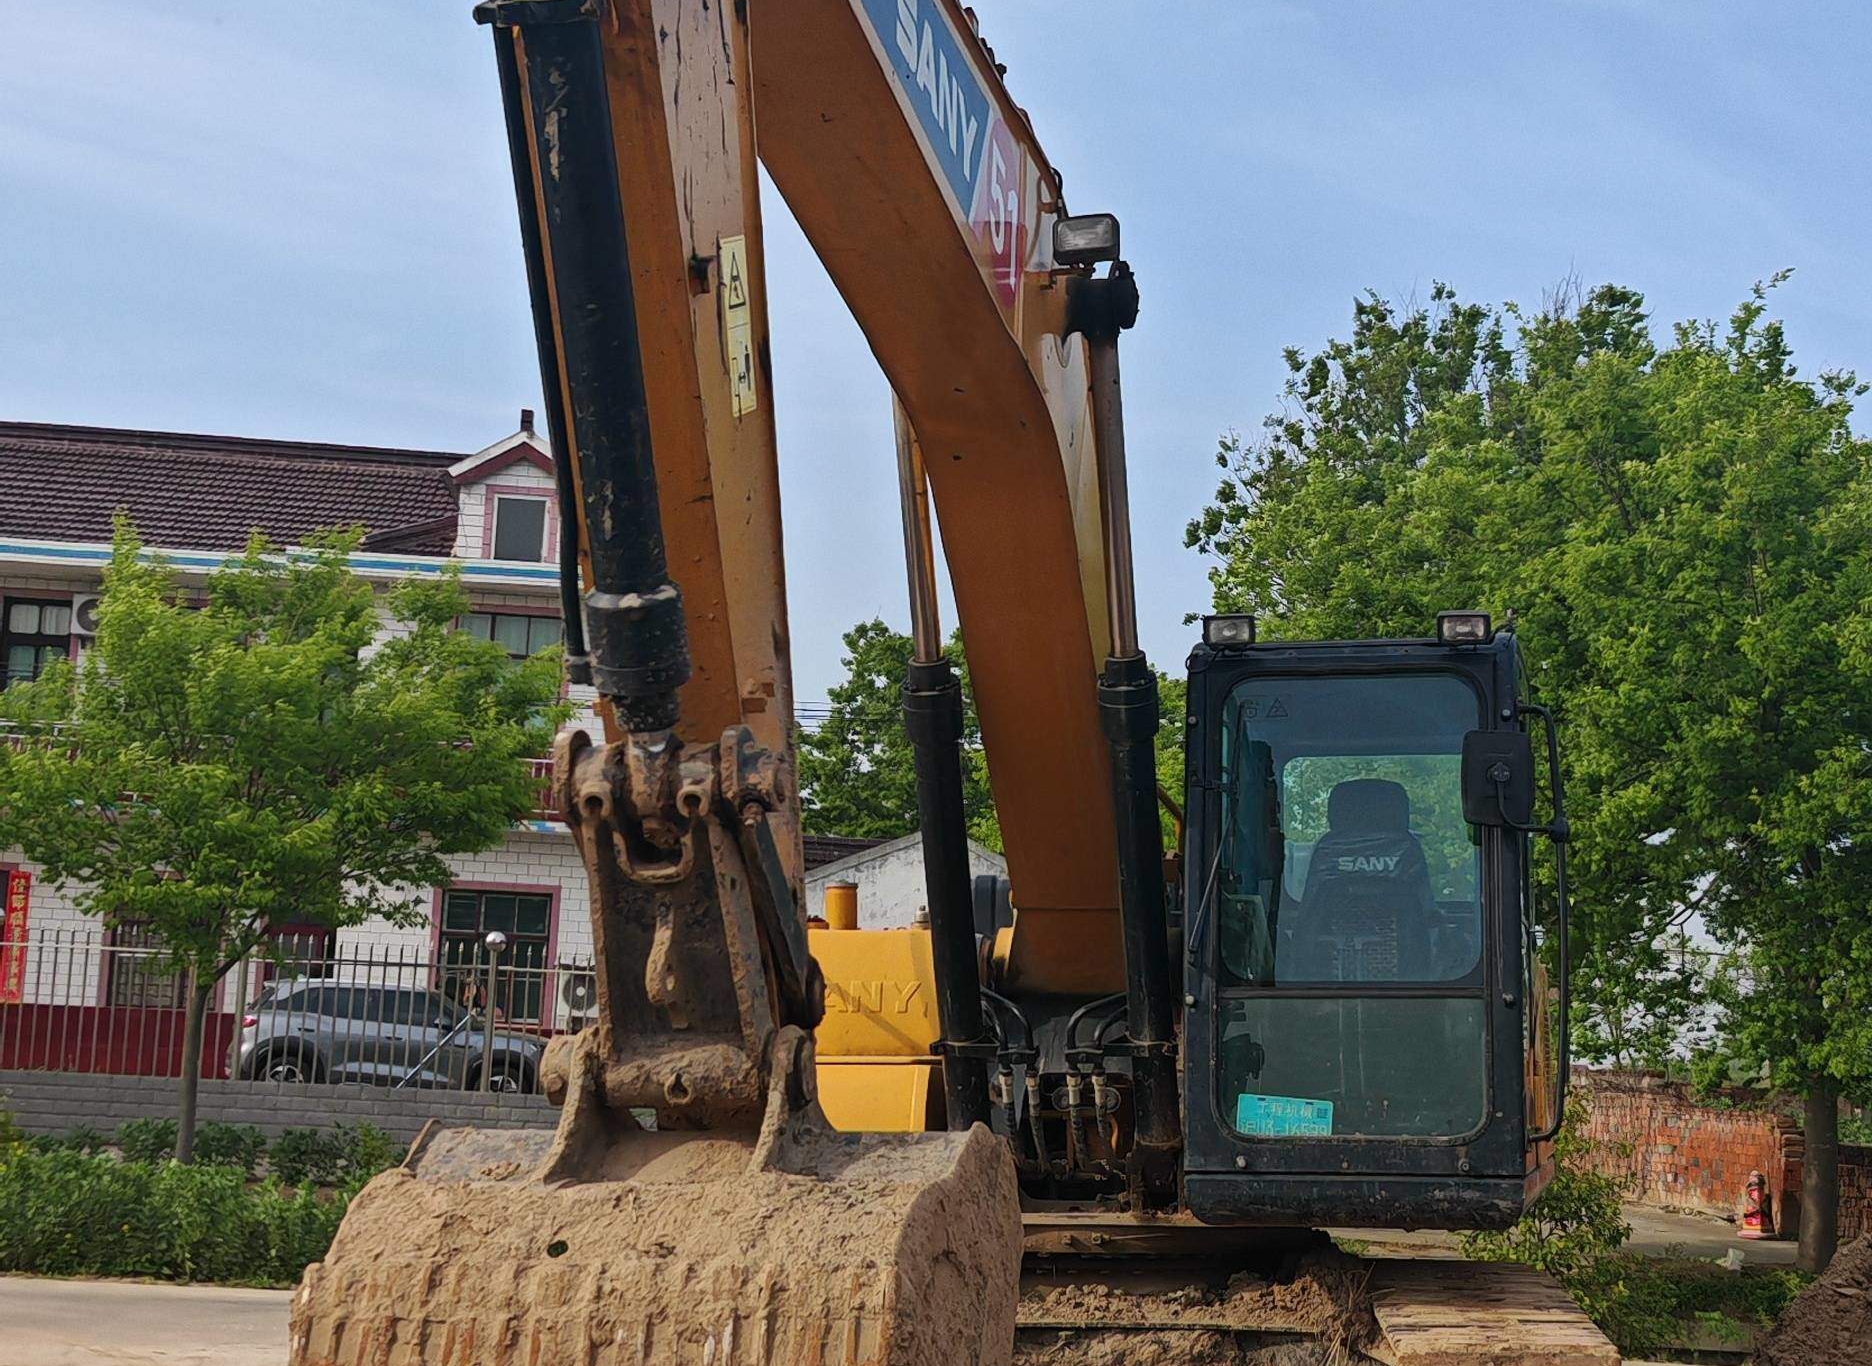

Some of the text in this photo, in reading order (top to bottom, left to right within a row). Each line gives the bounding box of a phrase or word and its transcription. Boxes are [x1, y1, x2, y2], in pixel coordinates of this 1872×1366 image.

[988, 138, 1020, 290] 51
[1337, 856, 1400, 871] SANY
[824, 980, 922, 1014] ANY
